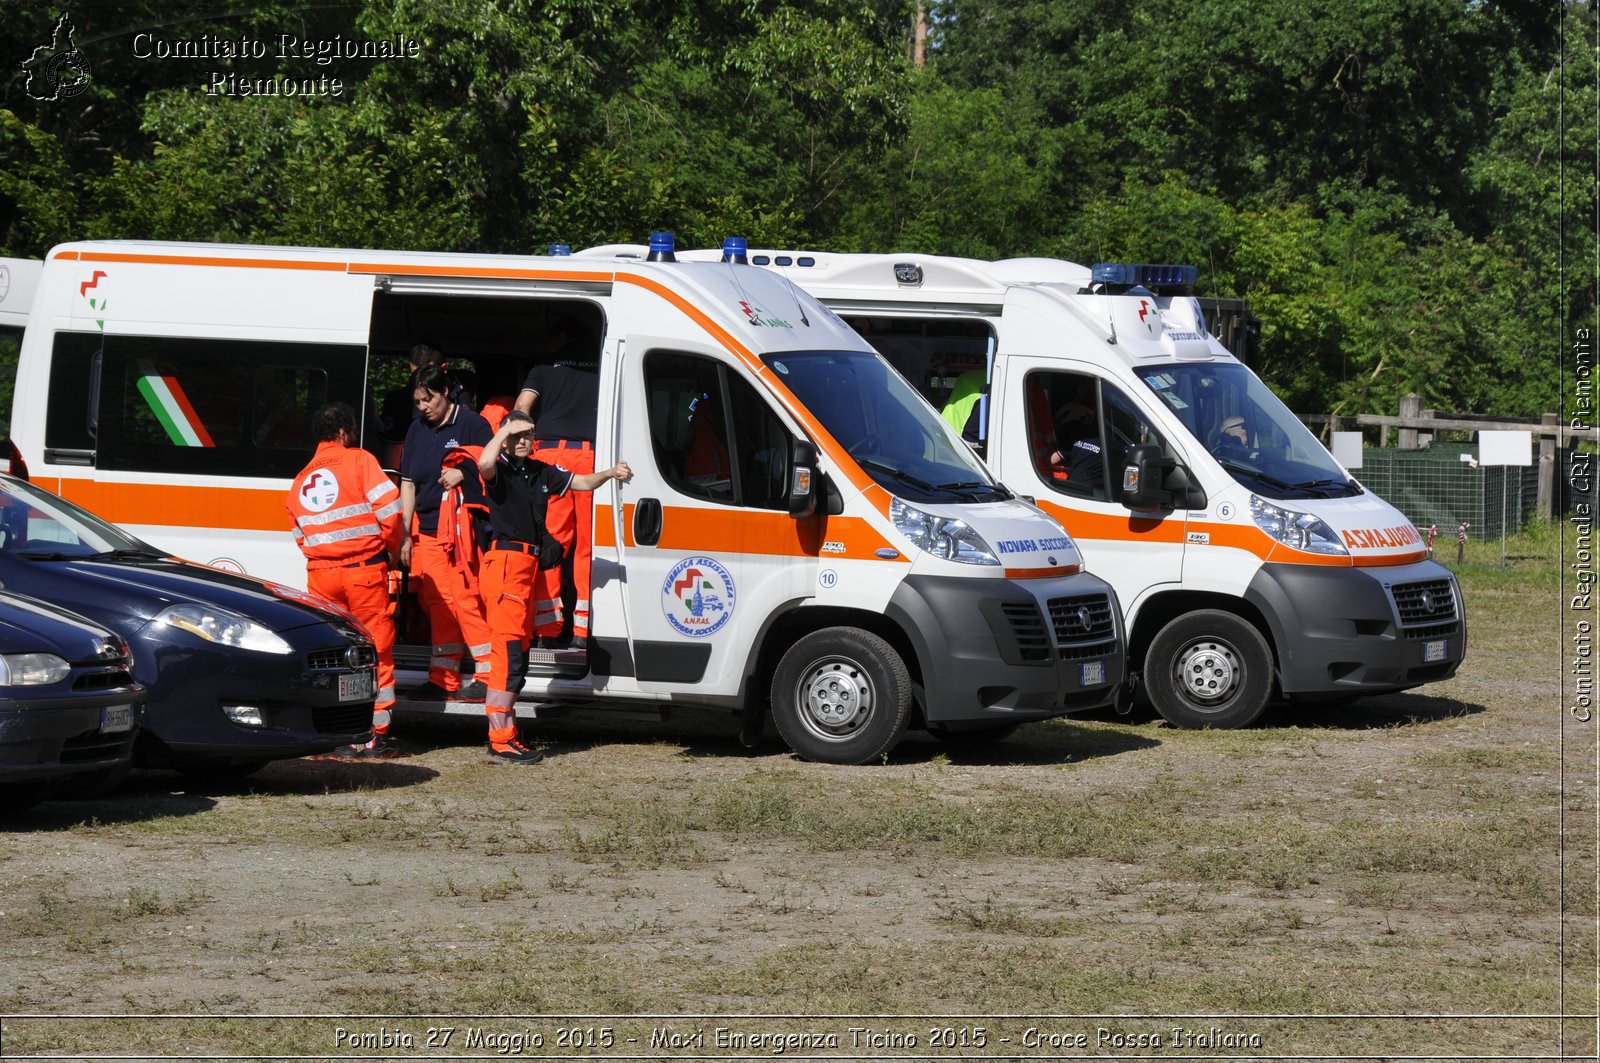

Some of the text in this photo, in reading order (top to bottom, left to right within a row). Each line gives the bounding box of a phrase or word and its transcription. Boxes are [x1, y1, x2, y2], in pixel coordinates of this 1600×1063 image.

[1222, 505, 1229, 515] 6
[997, 540, 1039, 554] NOVARA
[664, 559, 734, 598] PUBBLICA ASSISTENZA
[822, 573, 835, 585] 10
[667, 611, 729, 635] NOVARA SOCCORSO
